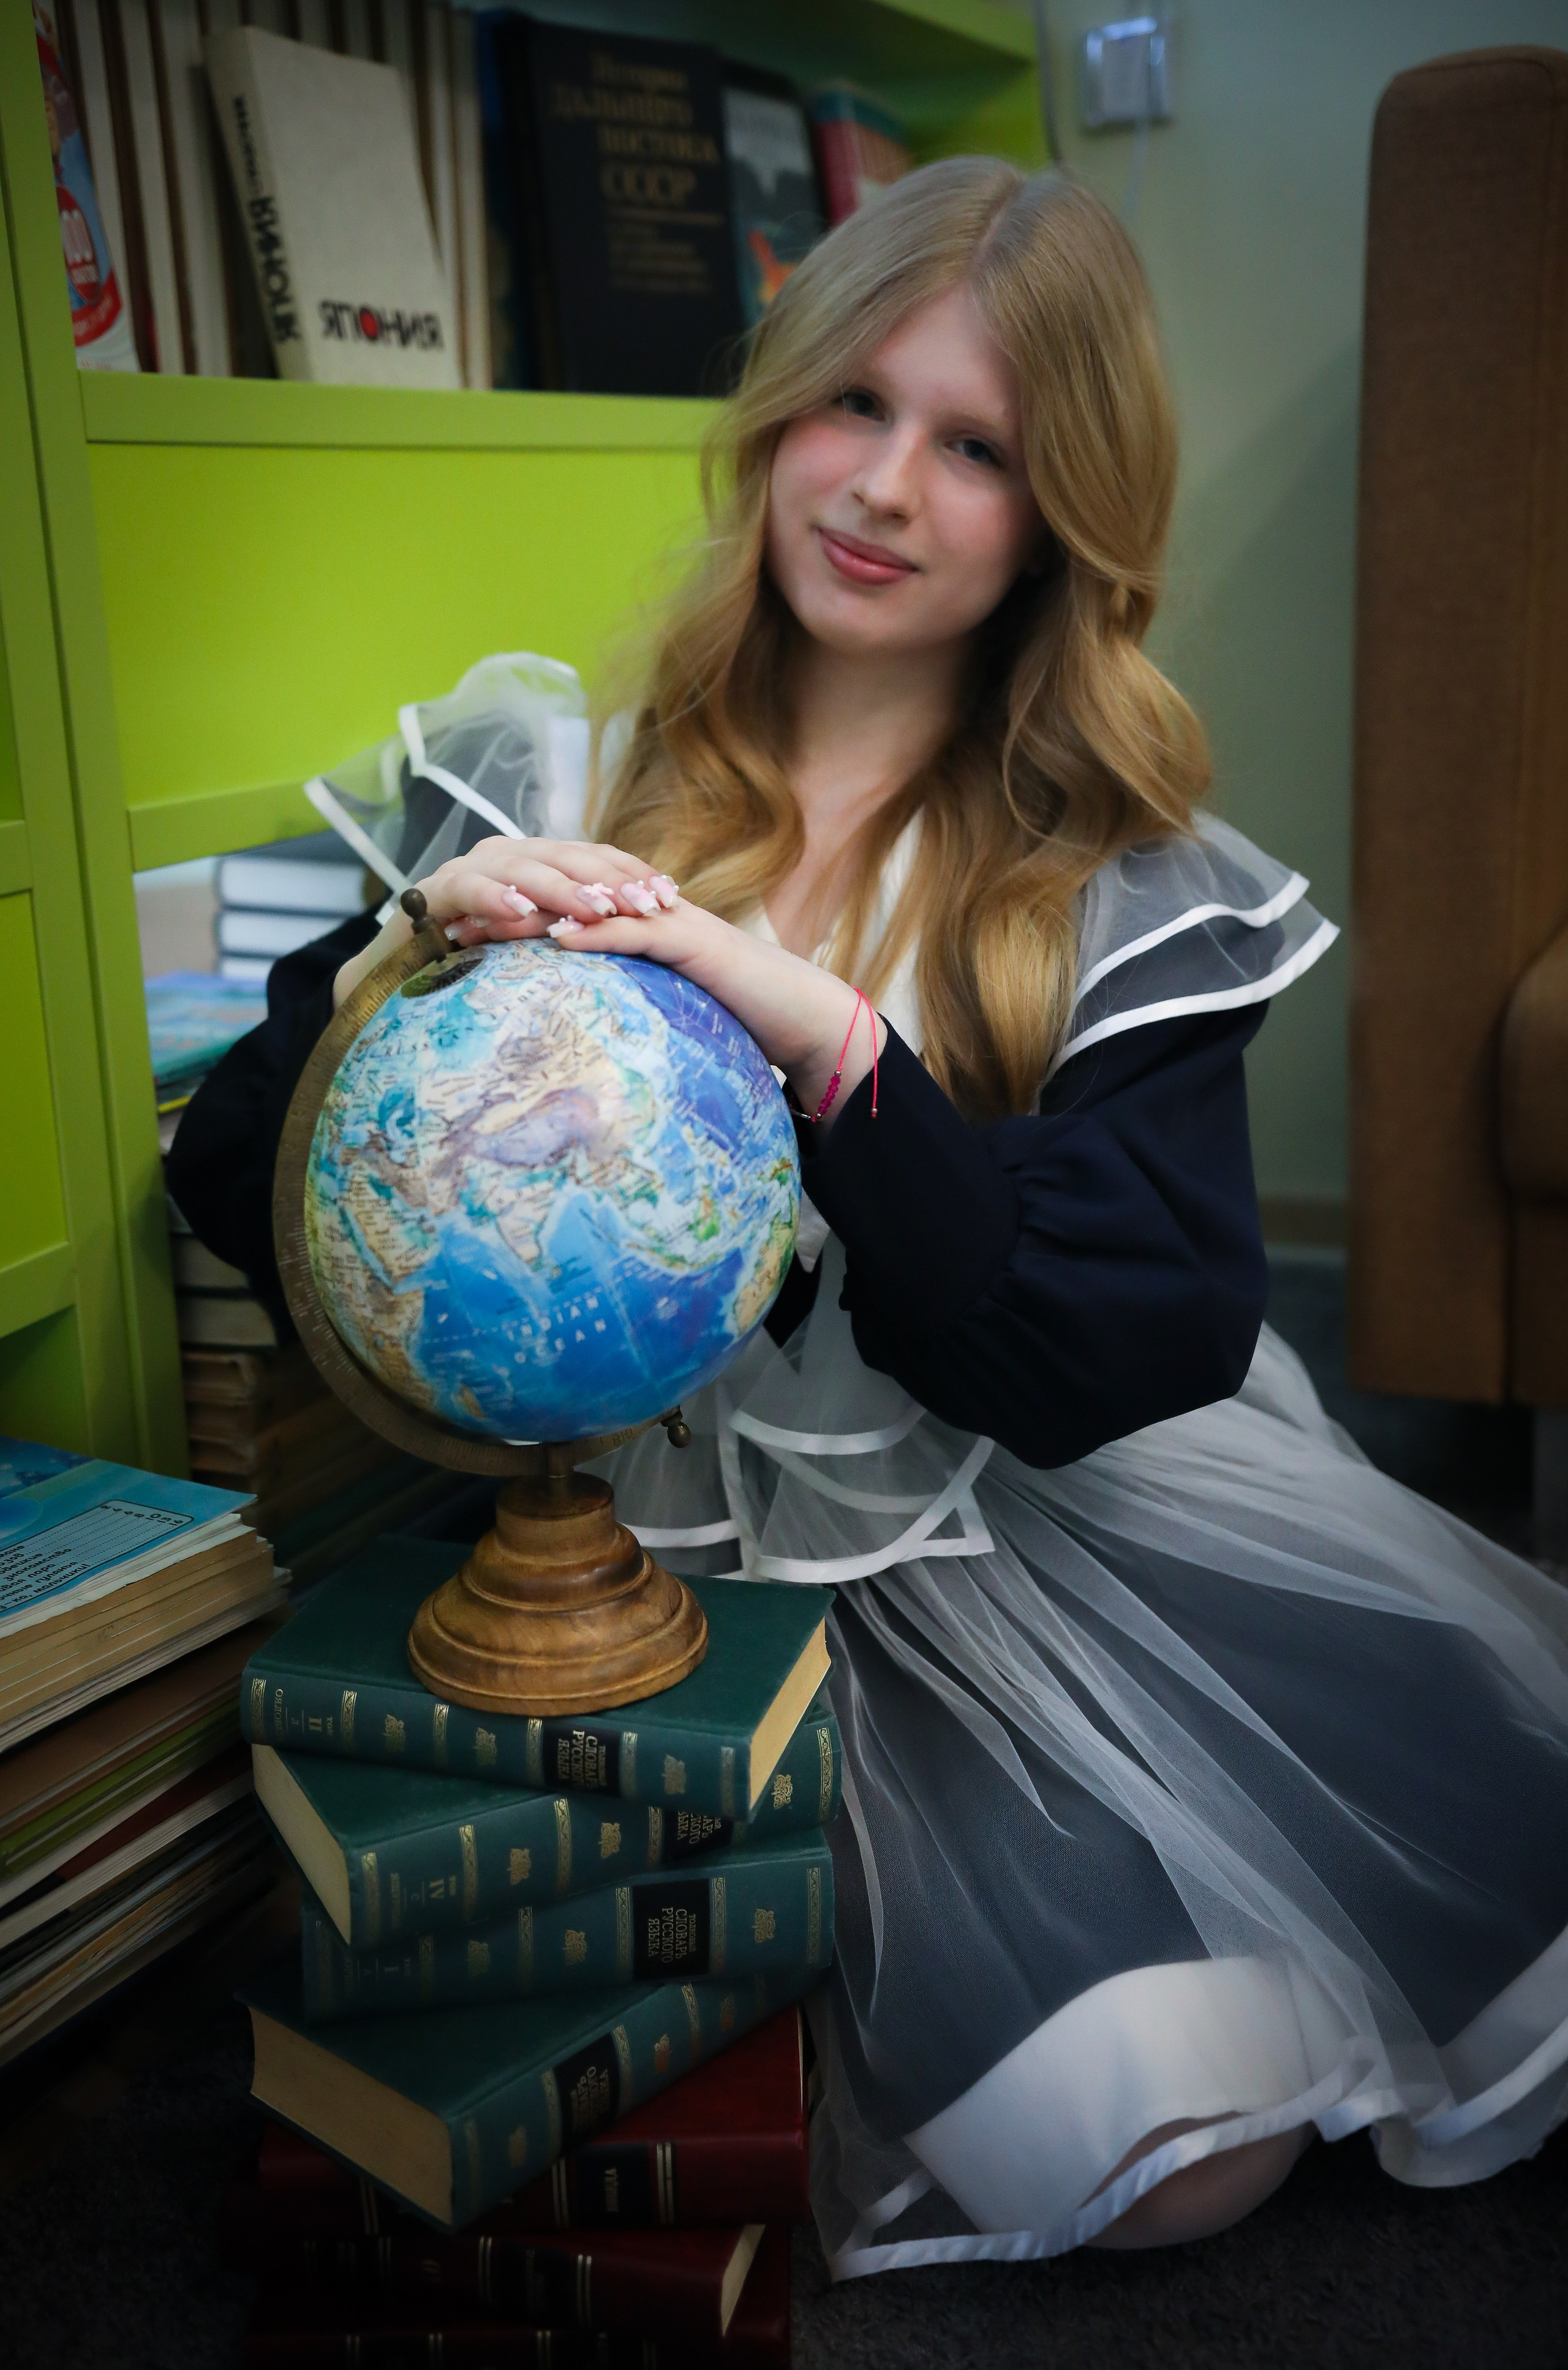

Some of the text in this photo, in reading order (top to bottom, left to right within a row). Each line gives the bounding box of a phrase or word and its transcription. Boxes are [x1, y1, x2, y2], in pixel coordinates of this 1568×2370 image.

[319, 300, 445, 350] ЯПОНИЯ
[507, 1295, 599, 1342] INDIAN
[514, 1318, 606, 1364] OCEAN
[3, 1548, 72, 1582] знакомство
[28, 1563, 56, 1579] пара
[33, 1563, 91, 1594] мальчики!
[36, 1561, 79, 1583] гулянья
[557, 1738, 570, 1781] ЯЗЫКА
[571, 1729, 585, 1790] РУССКОГО
[585, 1735, 598, 1790] СЛОВАРЬ
[648, 1918, 660, 1957] ЯЗЫКА
[661, 1906, 674, 1963] РУССКОГО
[675, 1908, 687, 1960] СЛОВАРЬ
[688, 1913, 697, 1952] ТОЛКОВЫЙ
